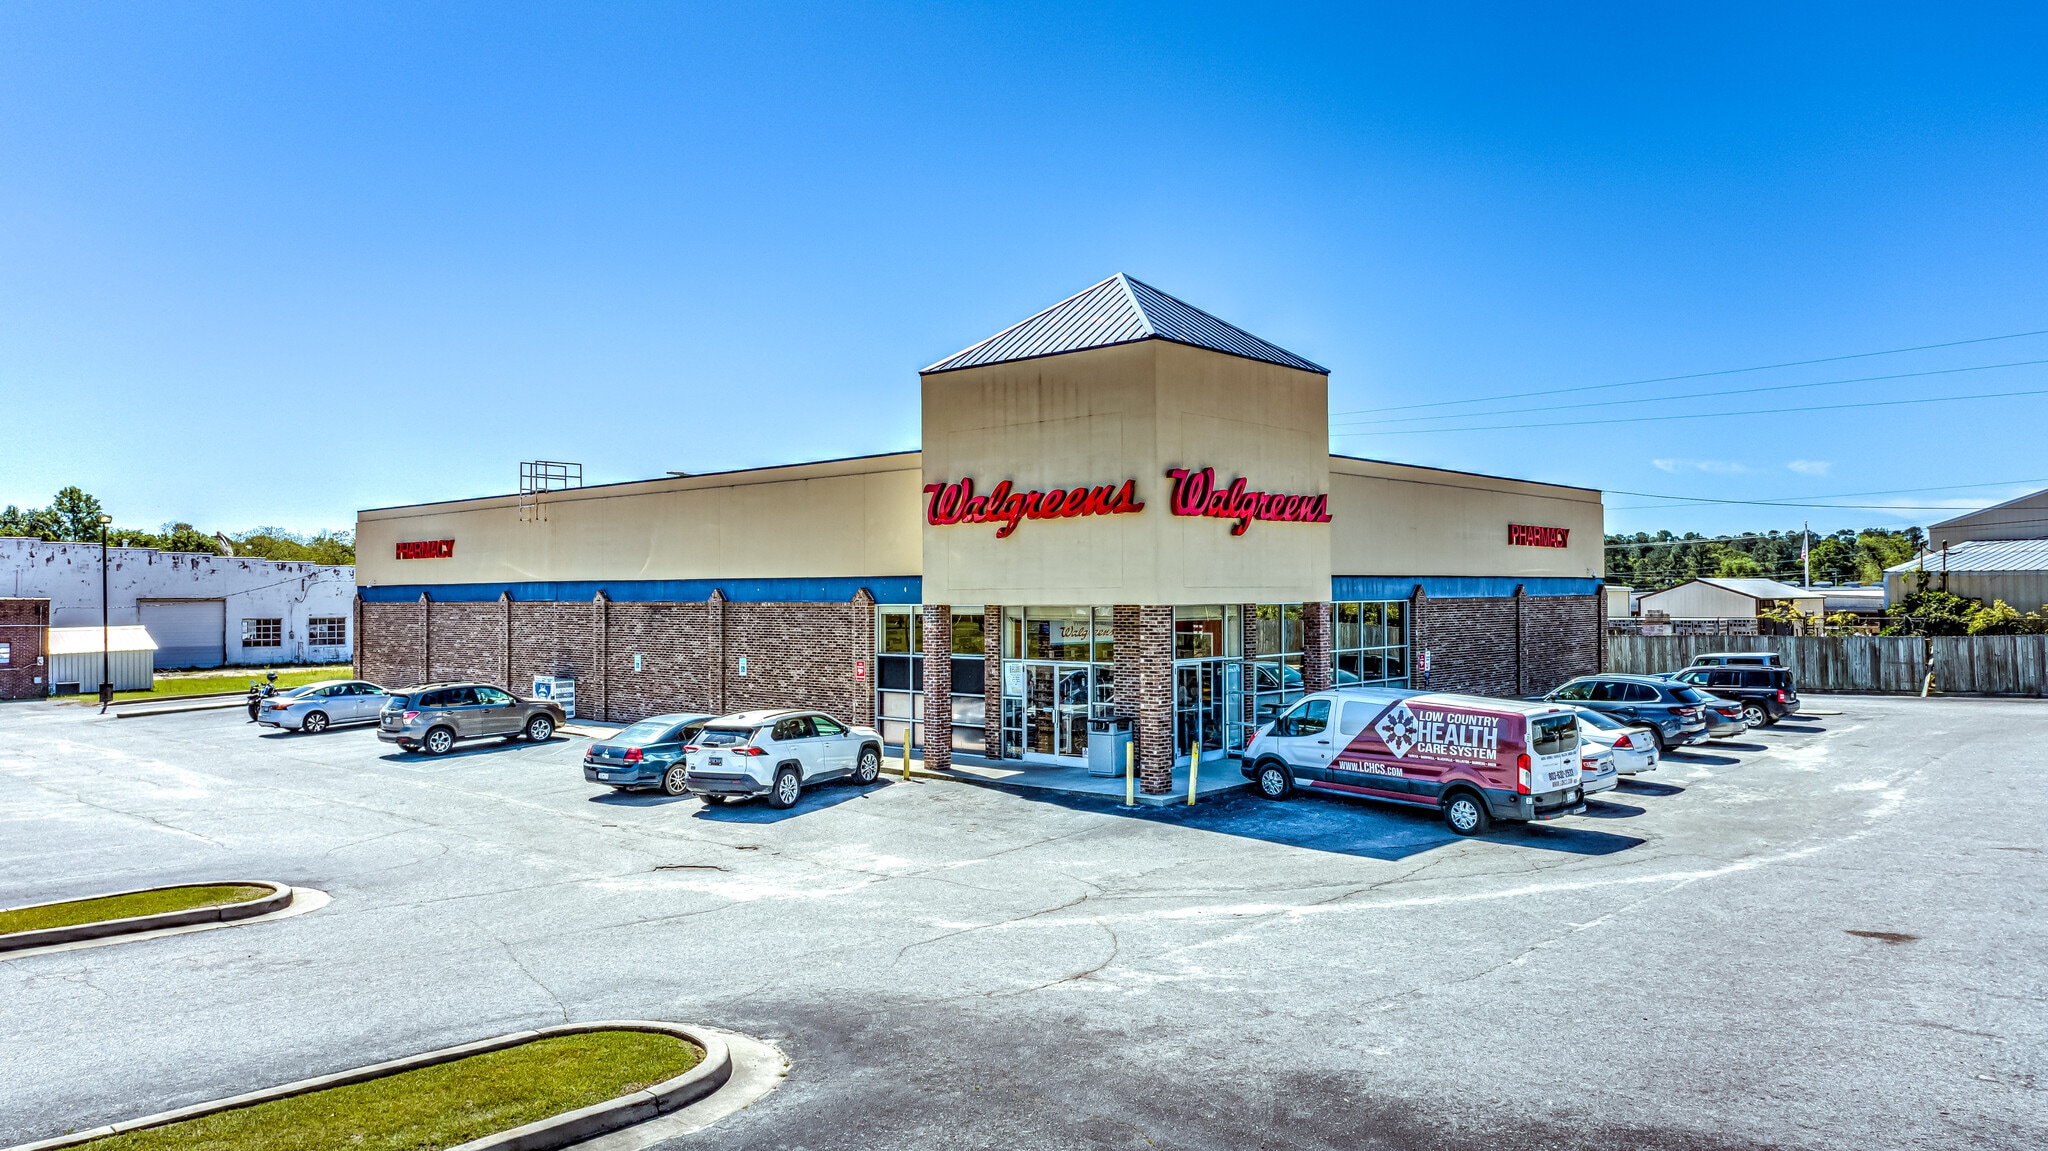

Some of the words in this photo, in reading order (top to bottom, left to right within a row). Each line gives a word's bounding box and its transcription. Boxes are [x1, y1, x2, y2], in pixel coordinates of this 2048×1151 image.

[923, 477, 1145, 538] Walgreens
[1166, 467, 1332, 536] Walgreens
[1508, 524, 1570, 548] PHARMACY
[395, 540, 455, 560] PHARMACY
[1420, 711, 1444, 722] LOW
[1447, 713, 1499, 727] COUNTRY
[1418, 721, 1498, 749] HEALTH
[1417, 743, 1448, 755] CARE
[1449, 745, 1497, 760] SYSTEM
[1339, 761, 1403, 777] WWW.LCHCS.COM
